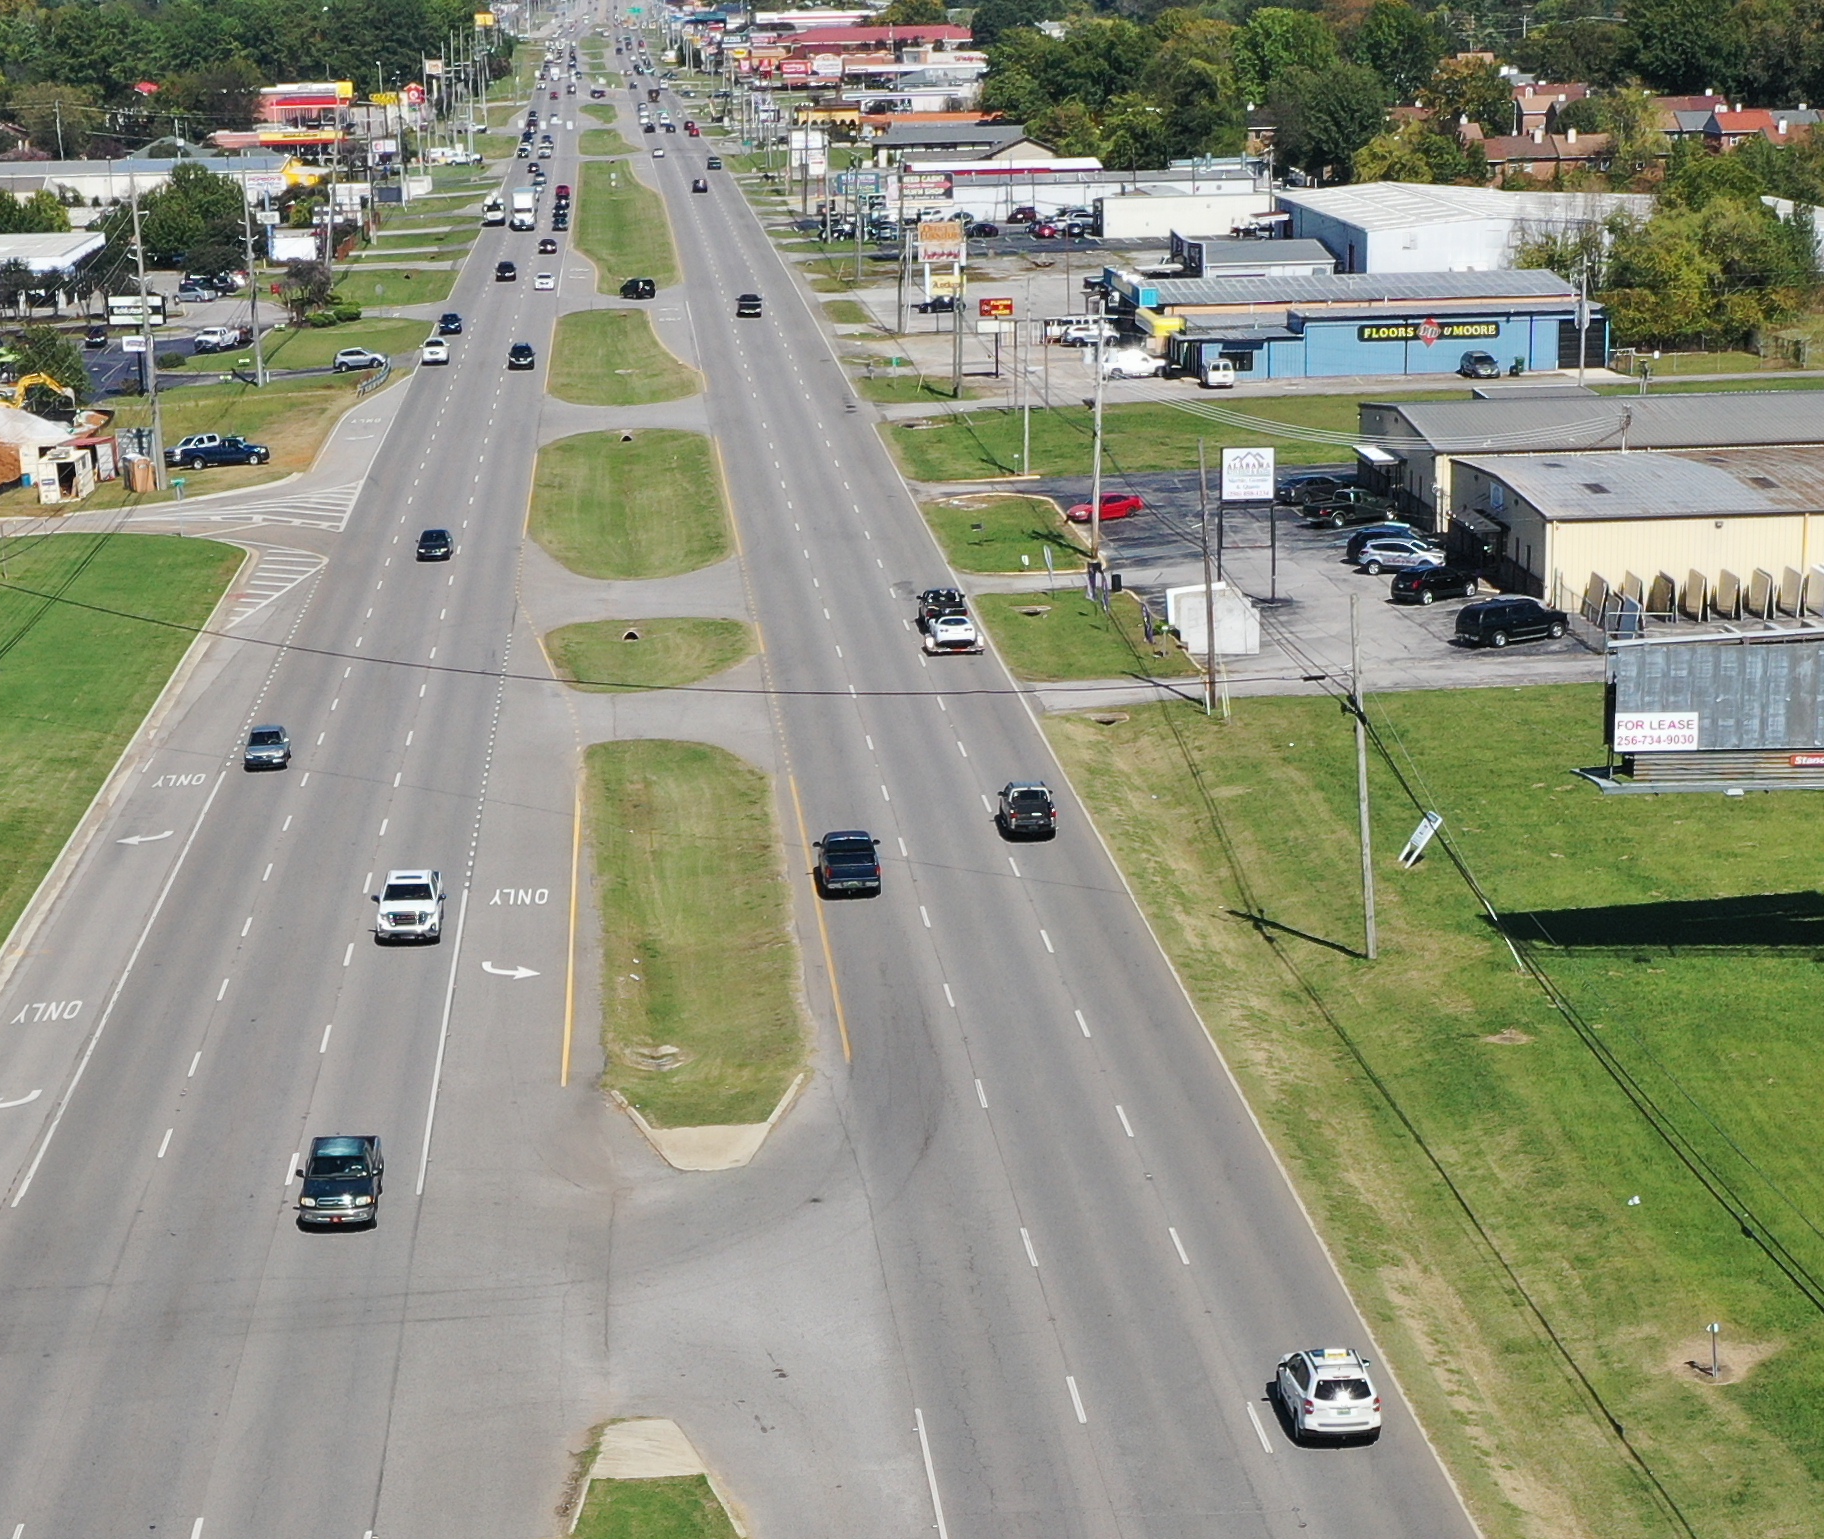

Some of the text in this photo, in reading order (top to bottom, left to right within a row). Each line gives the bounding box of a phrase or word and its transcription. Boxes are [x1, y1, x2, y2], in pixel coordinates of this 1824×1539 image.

[1364, 326, 1415, 339] FLOORS
[1453, 324, 1497, 336] MOORE
[1227, 461, 1271, 470] ALABAMA
[1617, 719, 1695, 731] FOR LEASE
[1617, 733, 1695, 746] 256-734-9030
[152, 773, 207, 789] ONLY
[488, 888, 550, 906] ONLY
[9, 1000, 84, 1025] ONLY
